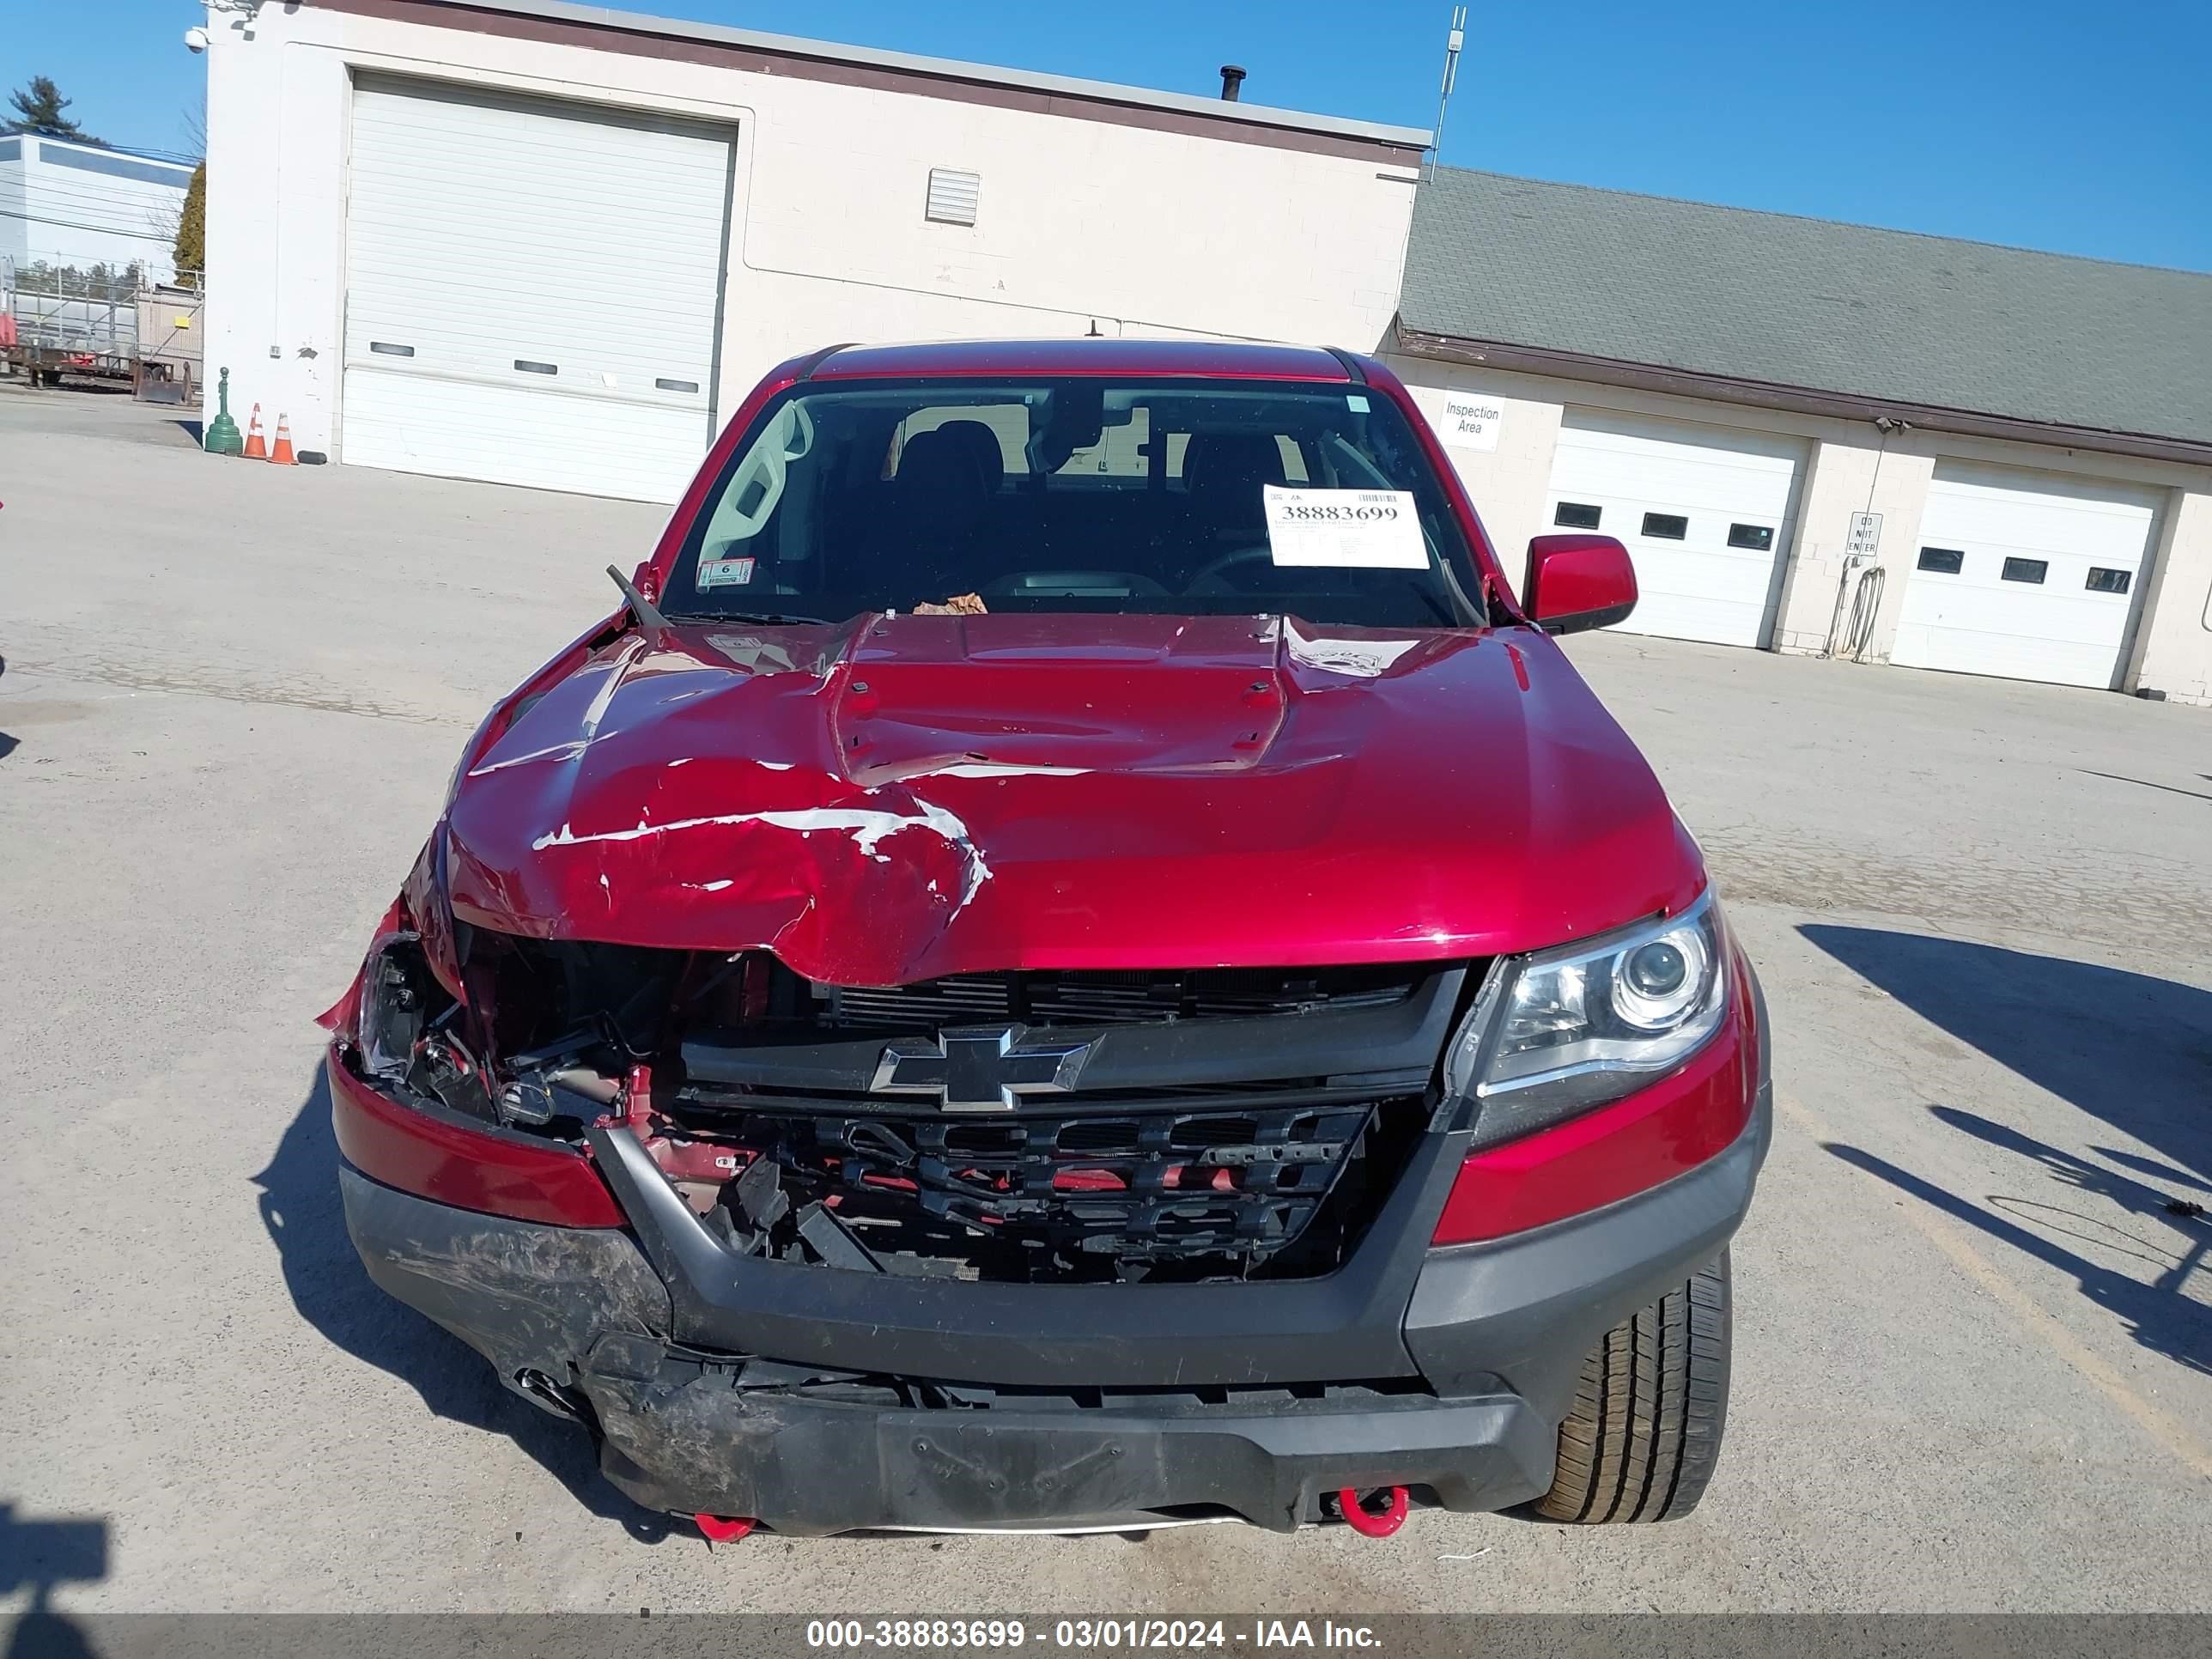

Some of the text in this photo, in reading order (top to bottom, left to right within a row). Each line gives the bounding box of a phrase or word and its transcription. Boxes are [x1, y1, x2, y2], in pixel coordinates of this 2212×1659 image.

[1447, 402, 1498, 419] Inspection
[1458, 420, 1482, 434] Area
[1282, 506, 1398, 520] 38883699
[721, 564, 731, 574] 6
